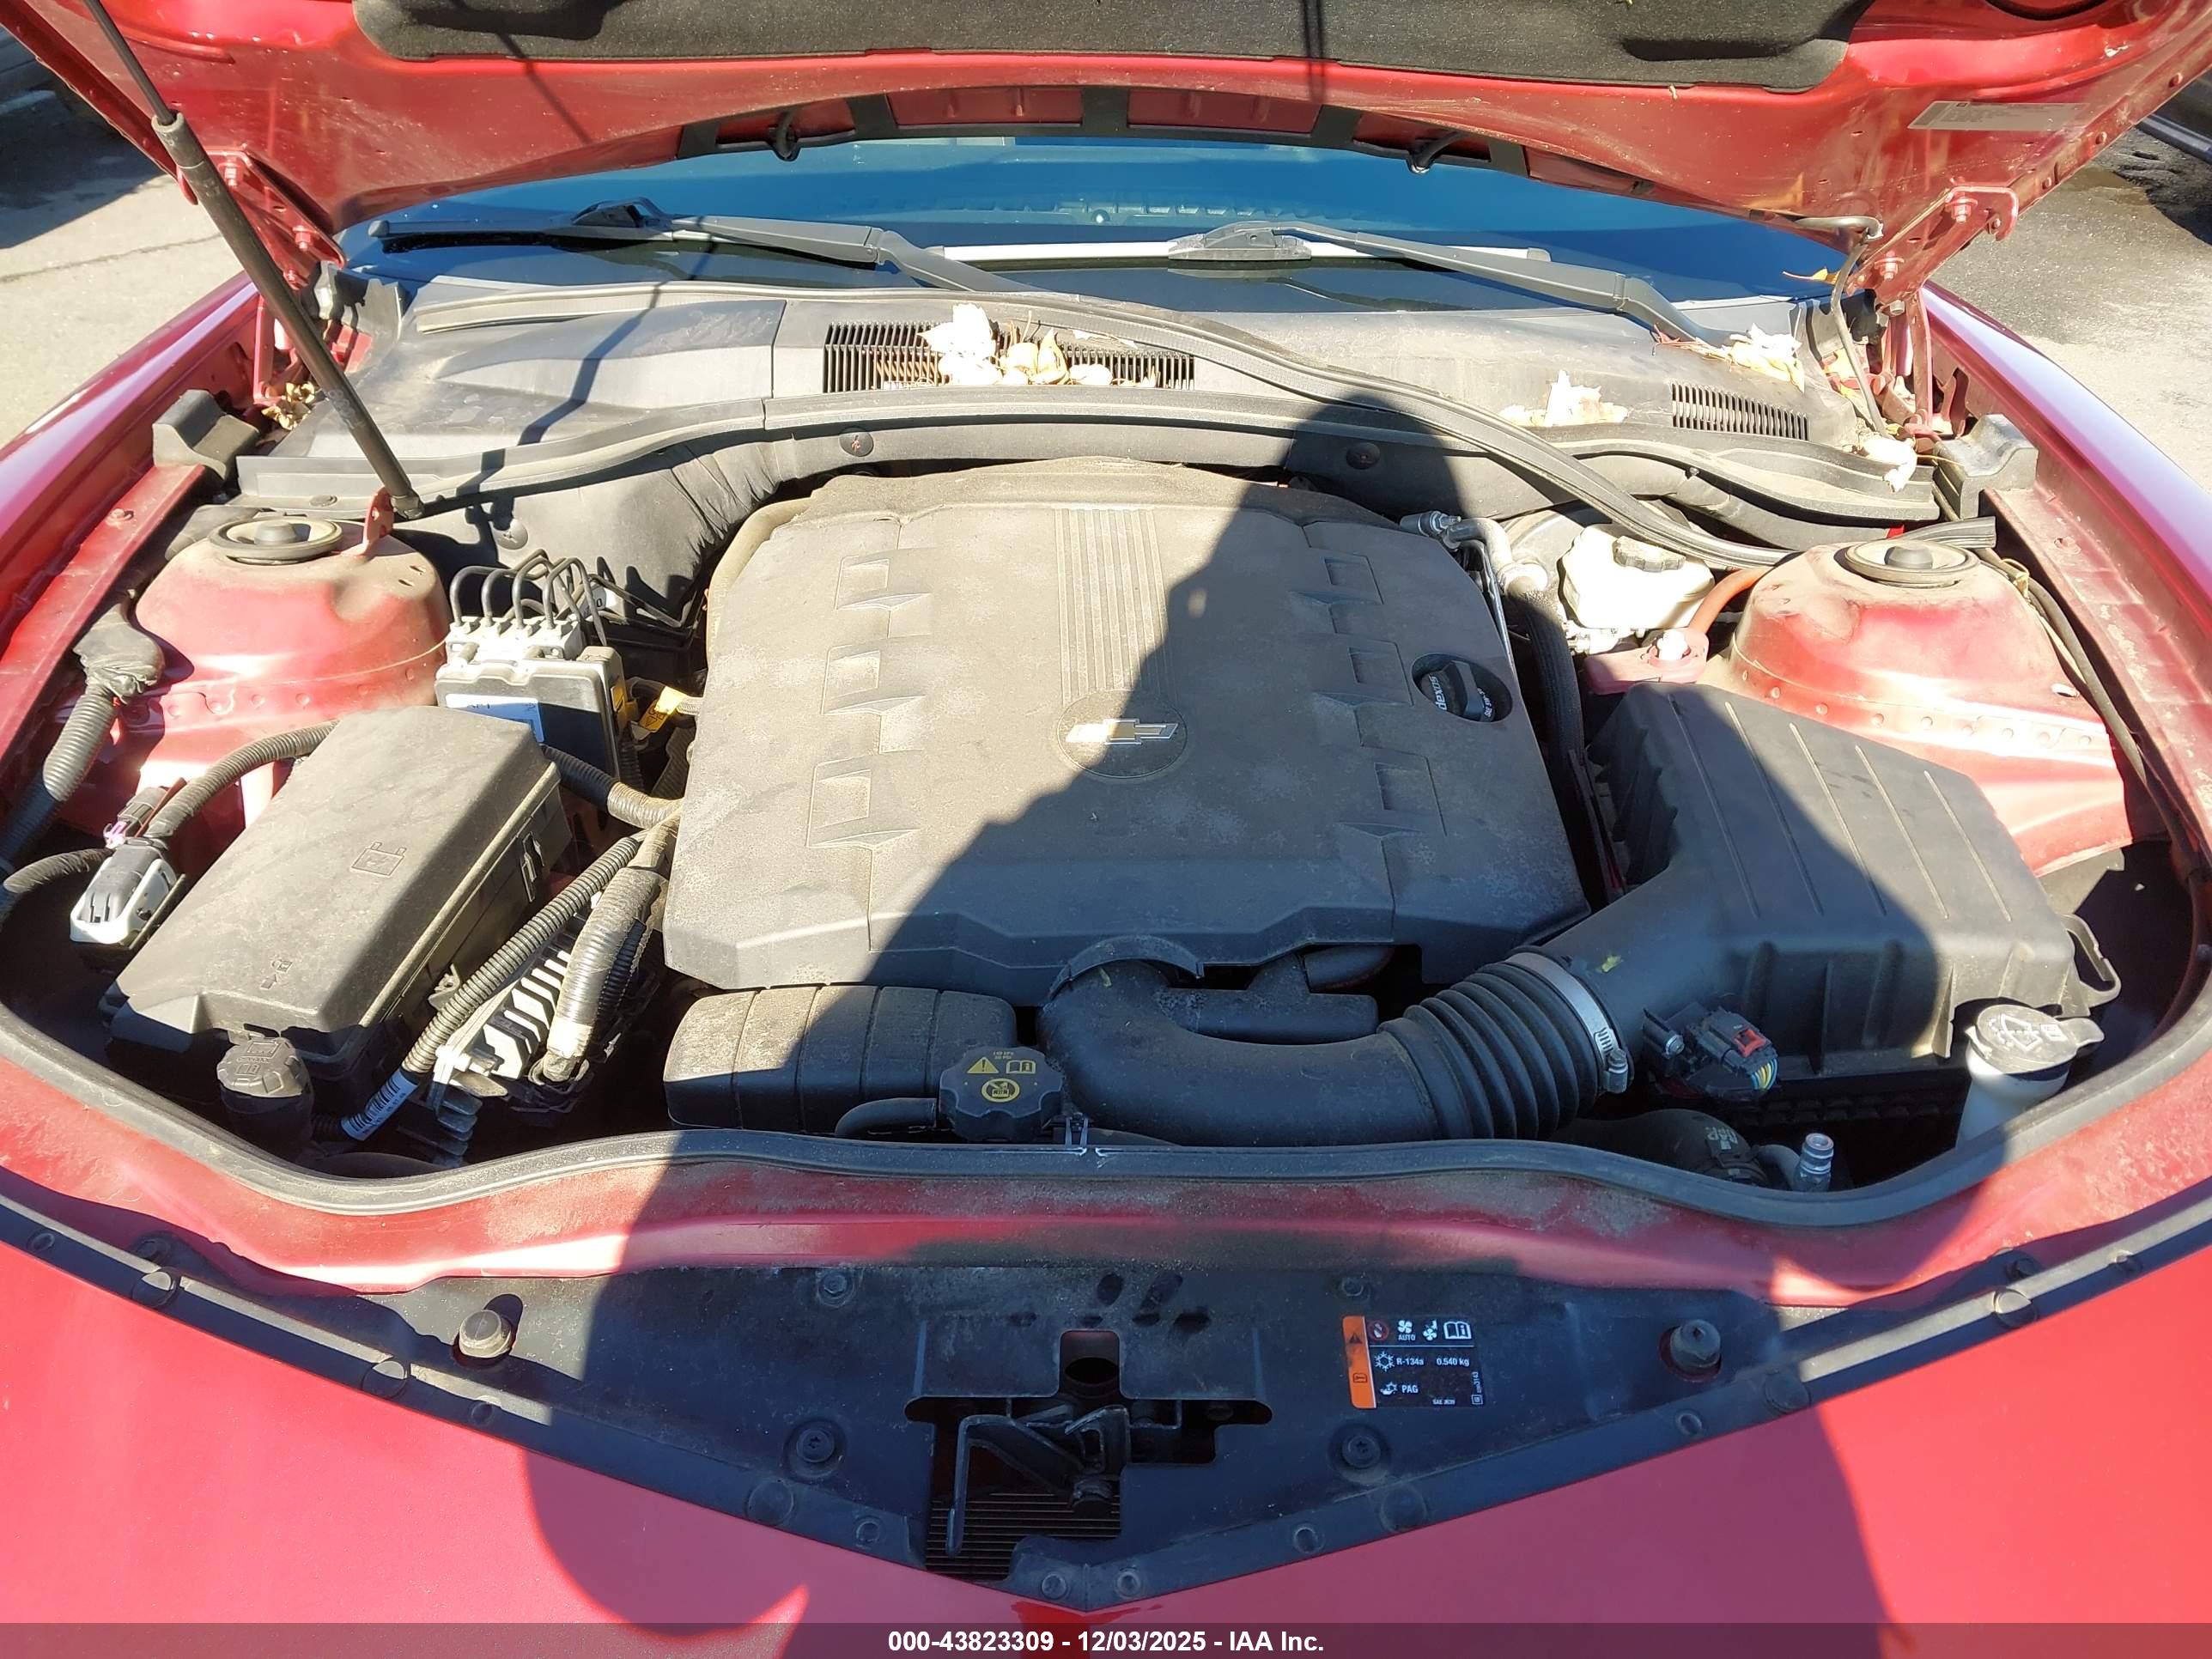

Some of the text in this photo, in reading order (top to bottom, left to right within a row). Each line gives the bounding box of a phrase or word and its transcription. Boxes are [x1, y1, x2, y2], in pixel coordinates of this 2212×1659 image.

[1428, 672, 1448, 711] dexos
[1396, 1358, 1470, 1367] R-134a 0.540 kg
[1401, 1385, 1419, 1394] PAG
